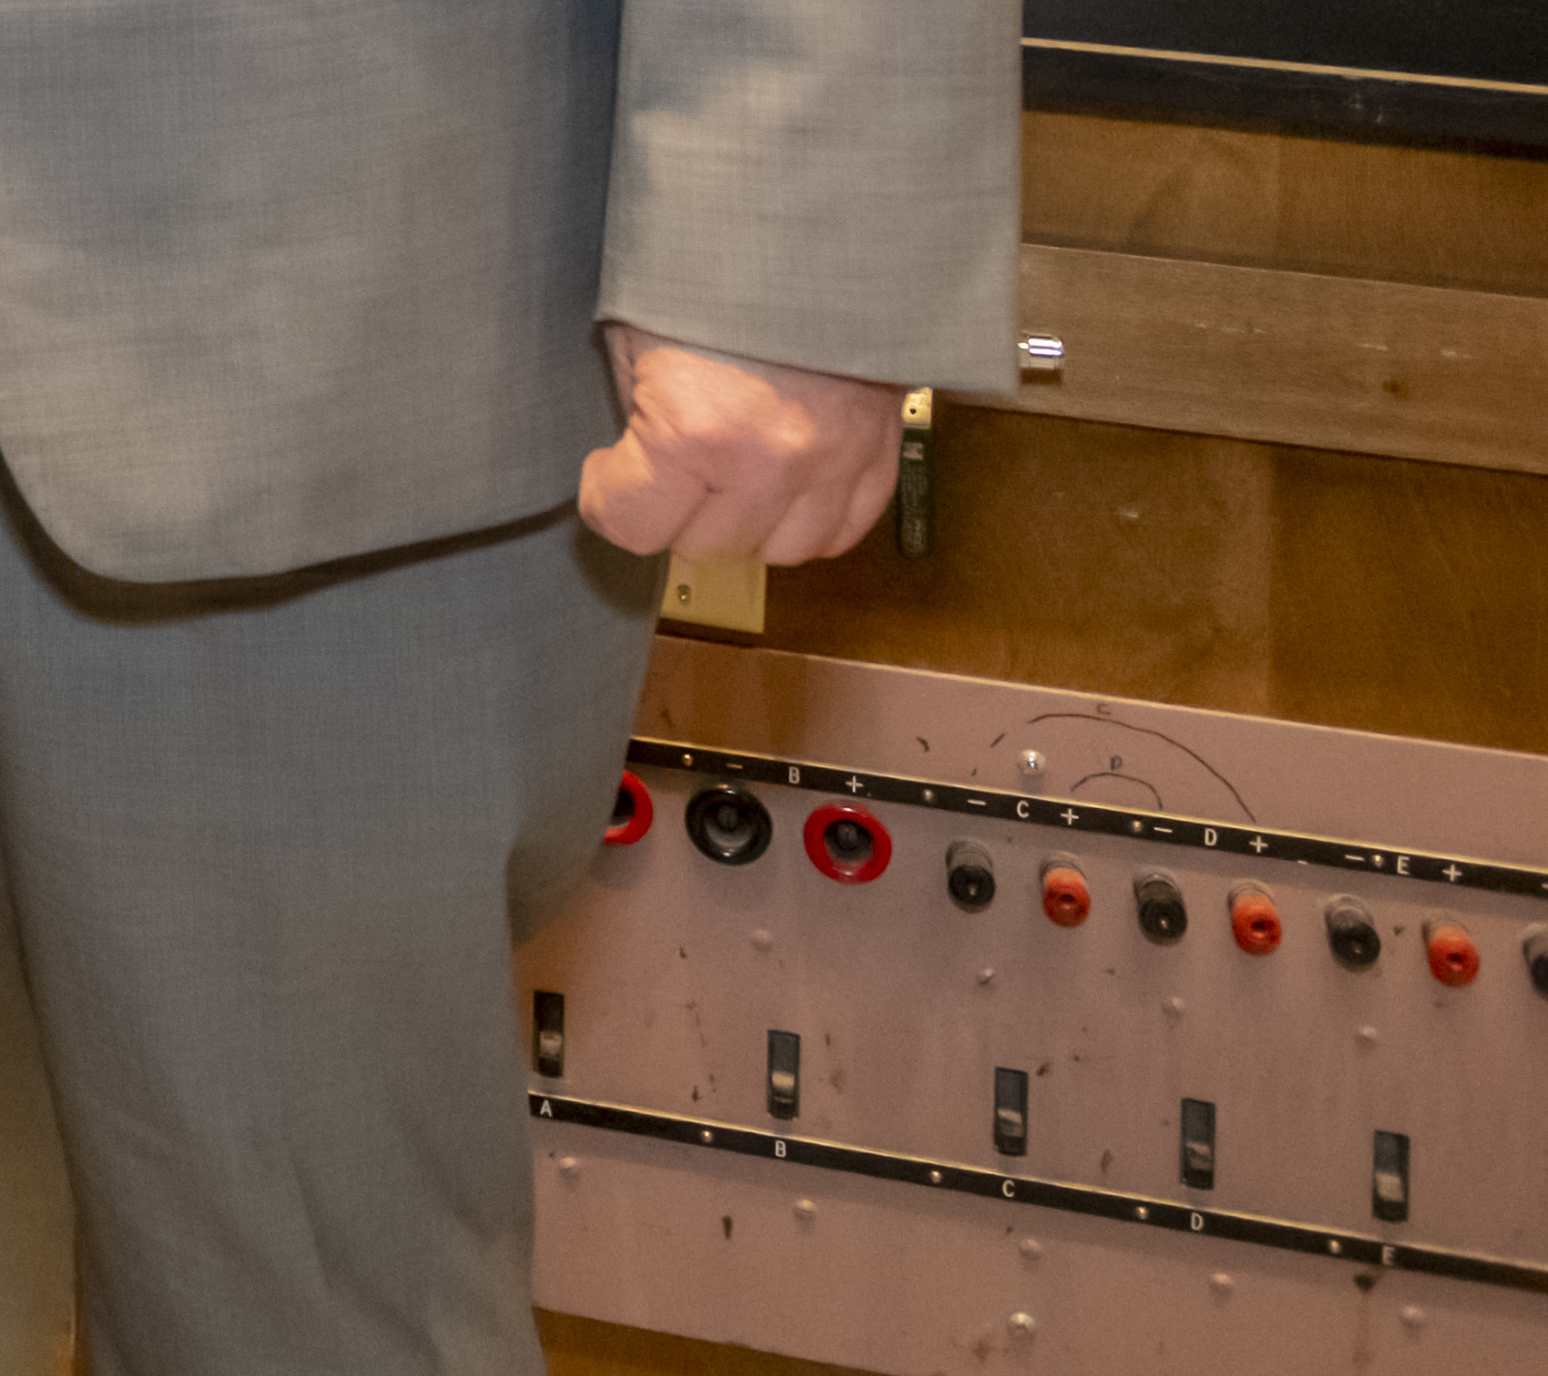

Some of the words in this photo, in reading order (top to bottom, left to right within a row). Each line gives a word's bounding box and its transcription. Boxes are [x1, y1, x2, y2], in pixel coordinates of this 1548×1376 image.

[789, 766, 801, 784] B
[1016, 800, 1030, 819] C
[1204, 828, 1218, 847] D
[1397, 856, 1411, 875] E
[540, 1100, 553, 1117] A
[775, 1140, 786, 1158] B
[1002, 1180, 1015, 1198] C
[1190, 1212, 1204, 1231] D
